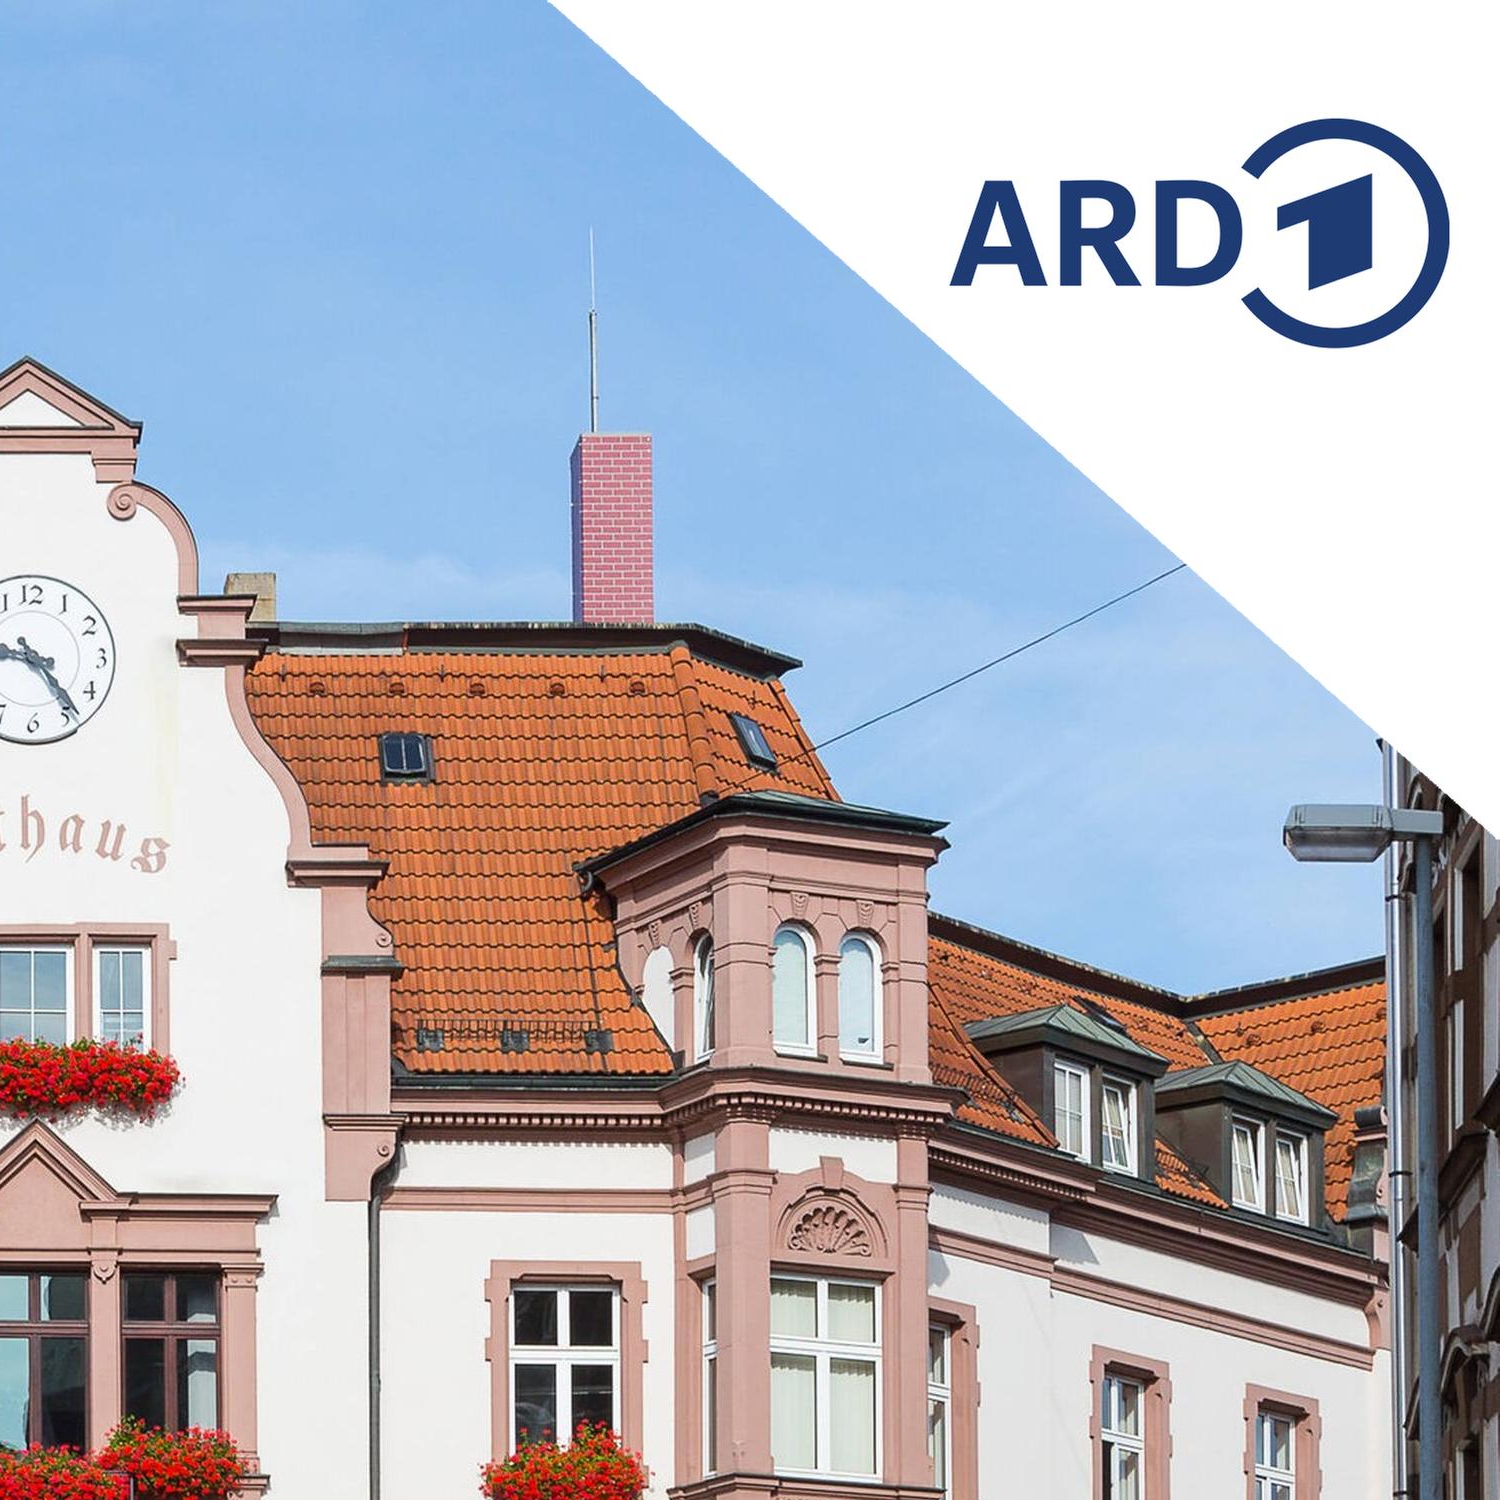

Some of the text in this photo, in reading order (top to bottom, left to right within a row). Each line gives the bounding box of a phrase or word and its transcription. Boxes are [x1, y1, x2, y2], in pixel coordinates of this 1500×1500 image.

[19, 584, 43, 606] 12
[60, 593, 68, 615] 1
[81, 615, 97, 636] 2
[95, 647, 107, 669] 3
[82, 680, 96, 701] 4
[26, 712, 40, 733] 6
